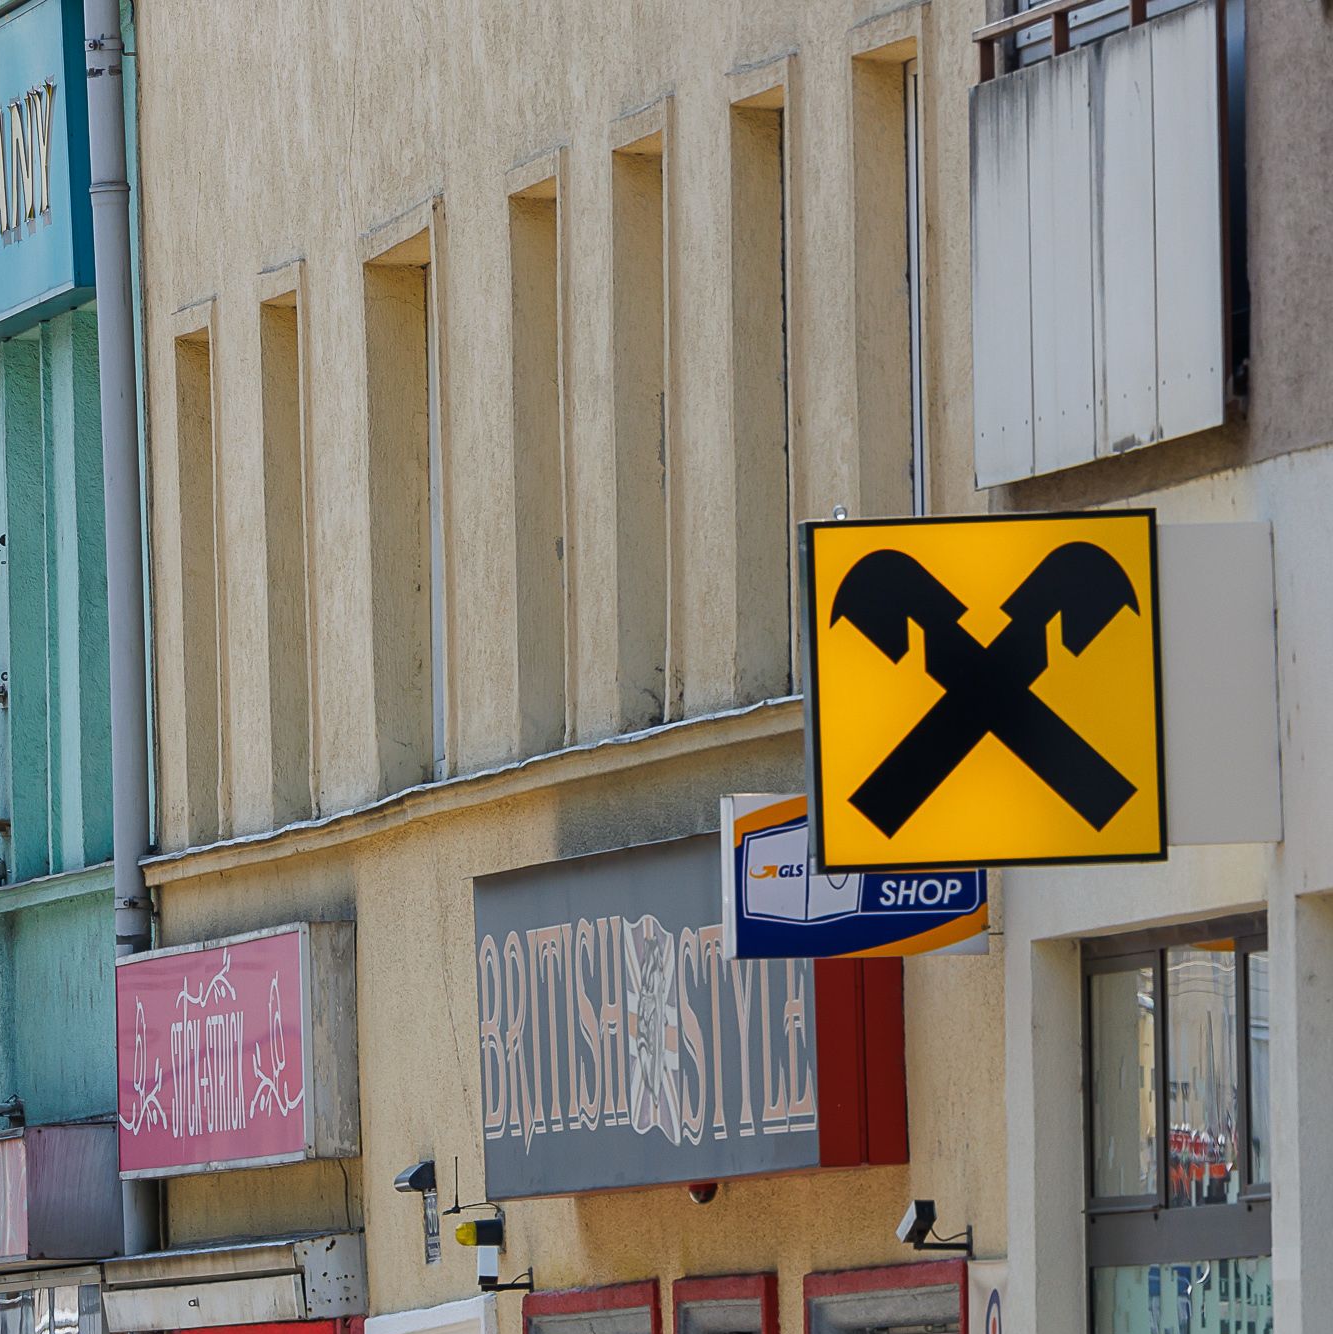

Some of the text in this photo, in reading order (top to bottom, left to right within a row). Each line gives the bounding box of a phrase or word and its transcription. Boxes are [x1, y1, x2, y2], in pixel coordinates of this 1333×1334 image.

[778, 864, 803, 878] GLS
[880, 879, 962, 905] SHOP
[479, 916, 818, 1152] BRITISH STYLE
